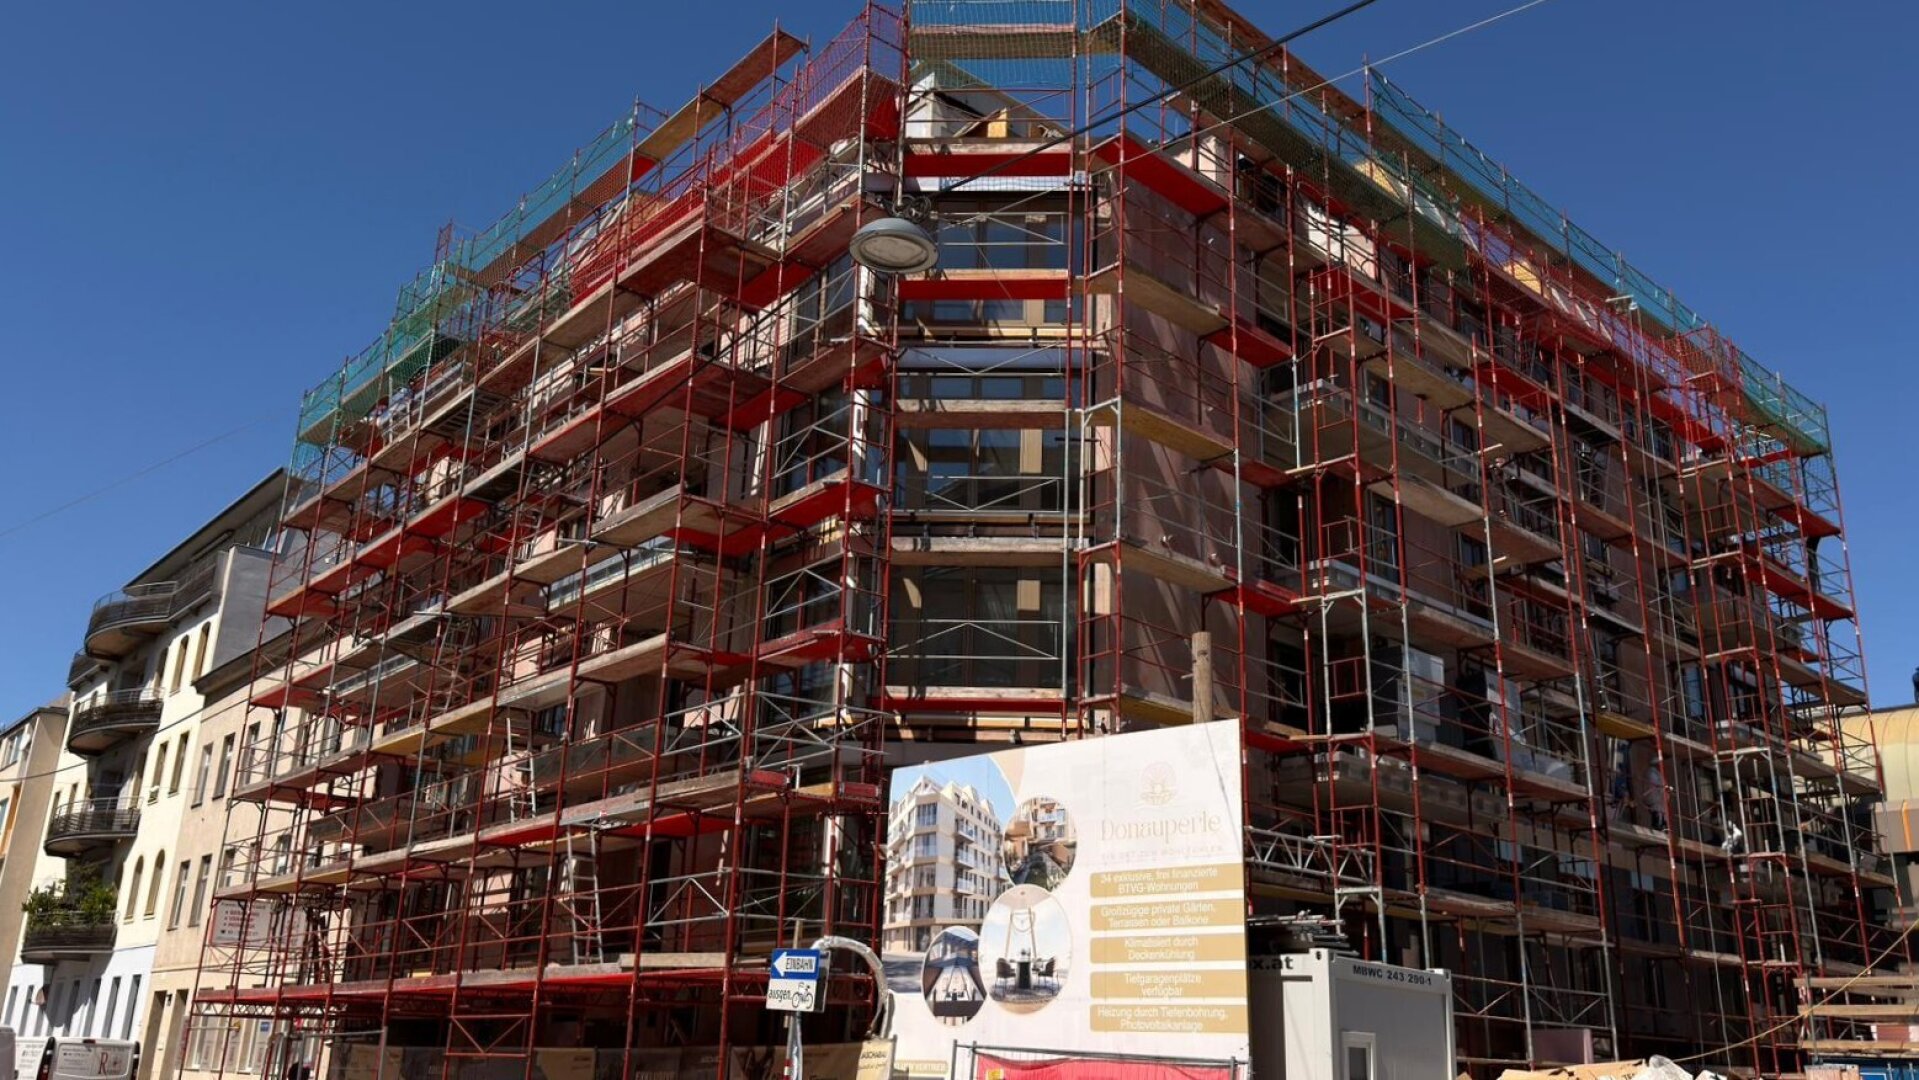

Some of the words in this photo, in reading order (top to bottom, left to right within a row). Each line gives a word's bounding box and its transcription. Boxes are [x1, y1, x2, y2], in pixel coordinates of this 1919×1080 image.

[1101, 810, 1222, 844] Donauperle
[1171, 866, 1218, 879] finanzierte
[1118, 880, 1199, 894] BTVG-Wohnungen
[1151, 903, 1180, 916] private
[1108, 917, 1149, 928] Terrassen
[1151, 916, 1170, 927] oder
[1173, 936, 1198, 947] durch
[785, 957, 814, 970] EINBAHN
[1097, 1006, 1133, 1018] Heizung
[1135, 1006, 1159, 1017] durch
